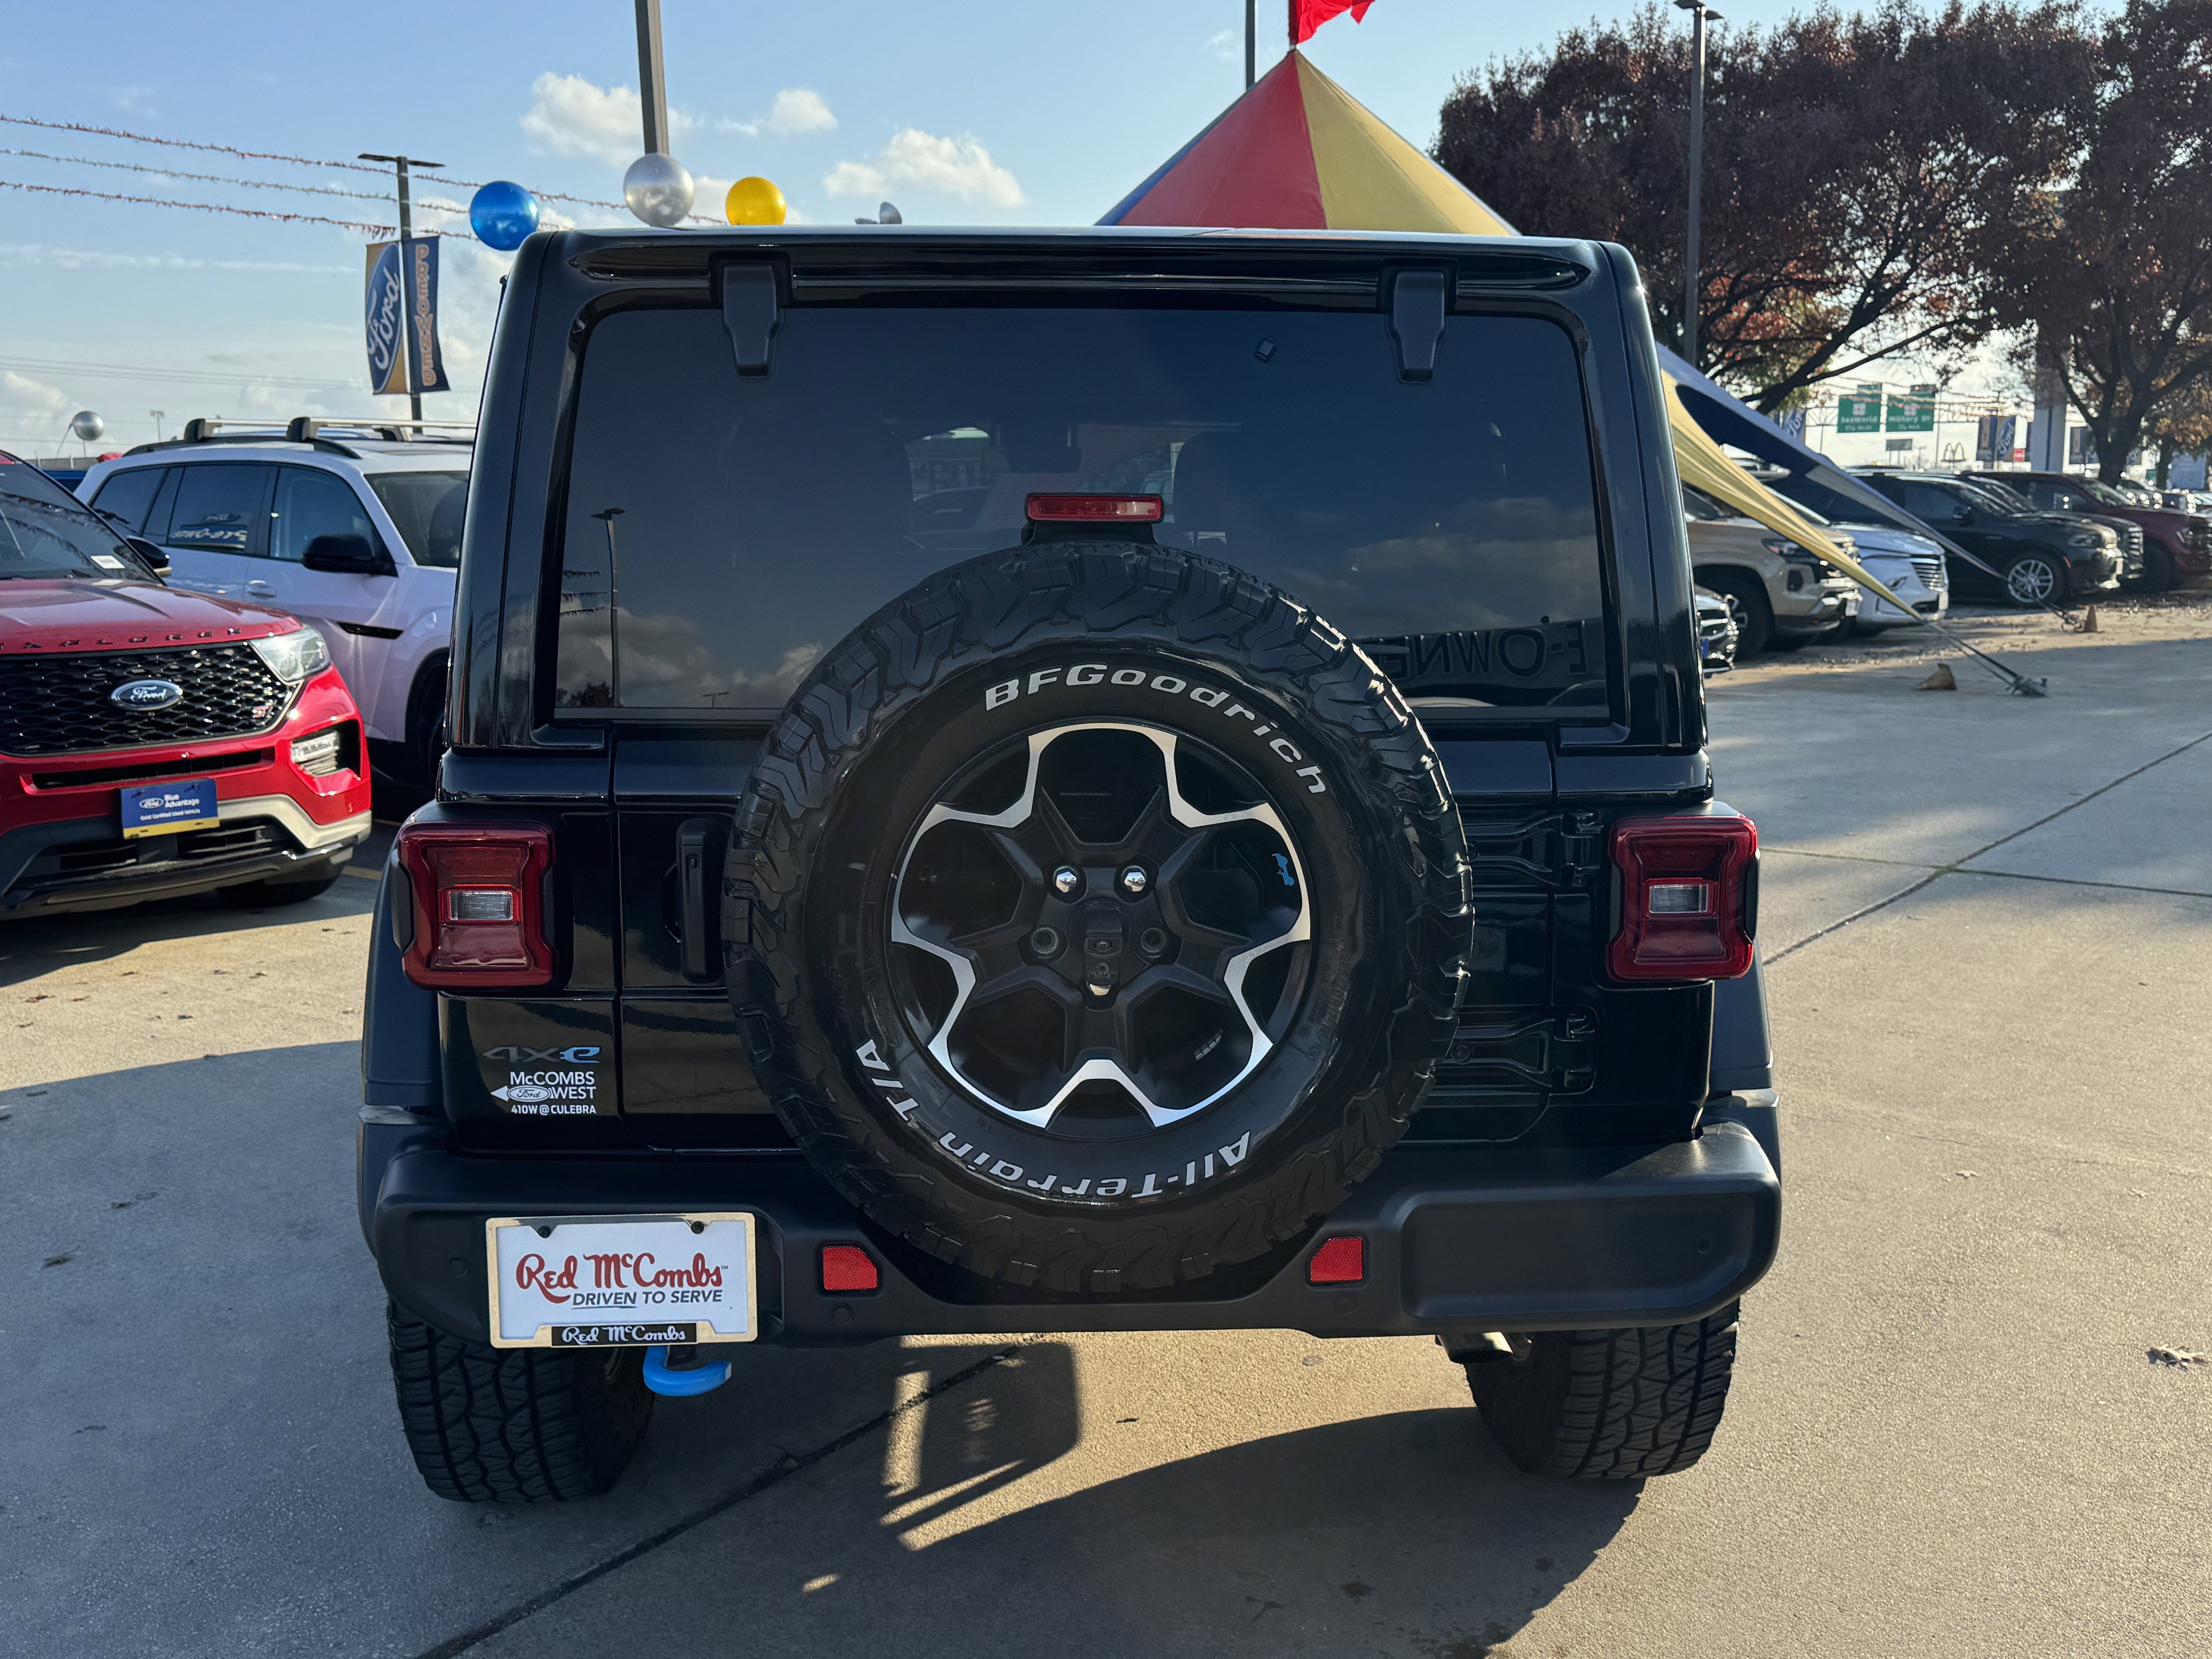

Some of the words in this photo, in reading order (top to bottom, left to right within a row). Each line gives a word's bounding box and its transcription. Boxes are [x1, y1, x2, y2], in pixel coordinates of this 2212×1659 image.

[368, 267, 400, 370] Ford
[0, 627, 241, 649] XPLORER
[130, 685, 167, 701] Ford
[985, 664, 1326, 793] BFGoodrich
[144, 799, 160, 808] Ford
[165, 799, 200, 808] Advantage
[483, 1046, 600, 1063] 4xe
[510, 1071, 595, 1085] McCOMBS
[856, 1039, 919, 1121] T/A
[517, 1089, 541, 1098] Ford
[551, 1086, 596, 1099] WEST
[511, 1104, 538, 1114] 410W
[539, 1104, 550, 1115] @
[551, 1104, 596, 1114] CULEBRA
[939, 1130, 1251, 1199] All-Terrain
[515, 1253, 579, 1304] Red
[583, 1252, 722, 1289] McCombs
[572, 1291, 637, 1306] DRIVEN
[642, 1291, 666, 1304] TO
[670, 1290, 723, 1303] SERVE
[562, 1326, 599, 1345] Red
[601, 1325, 686, 1342] McCombs
